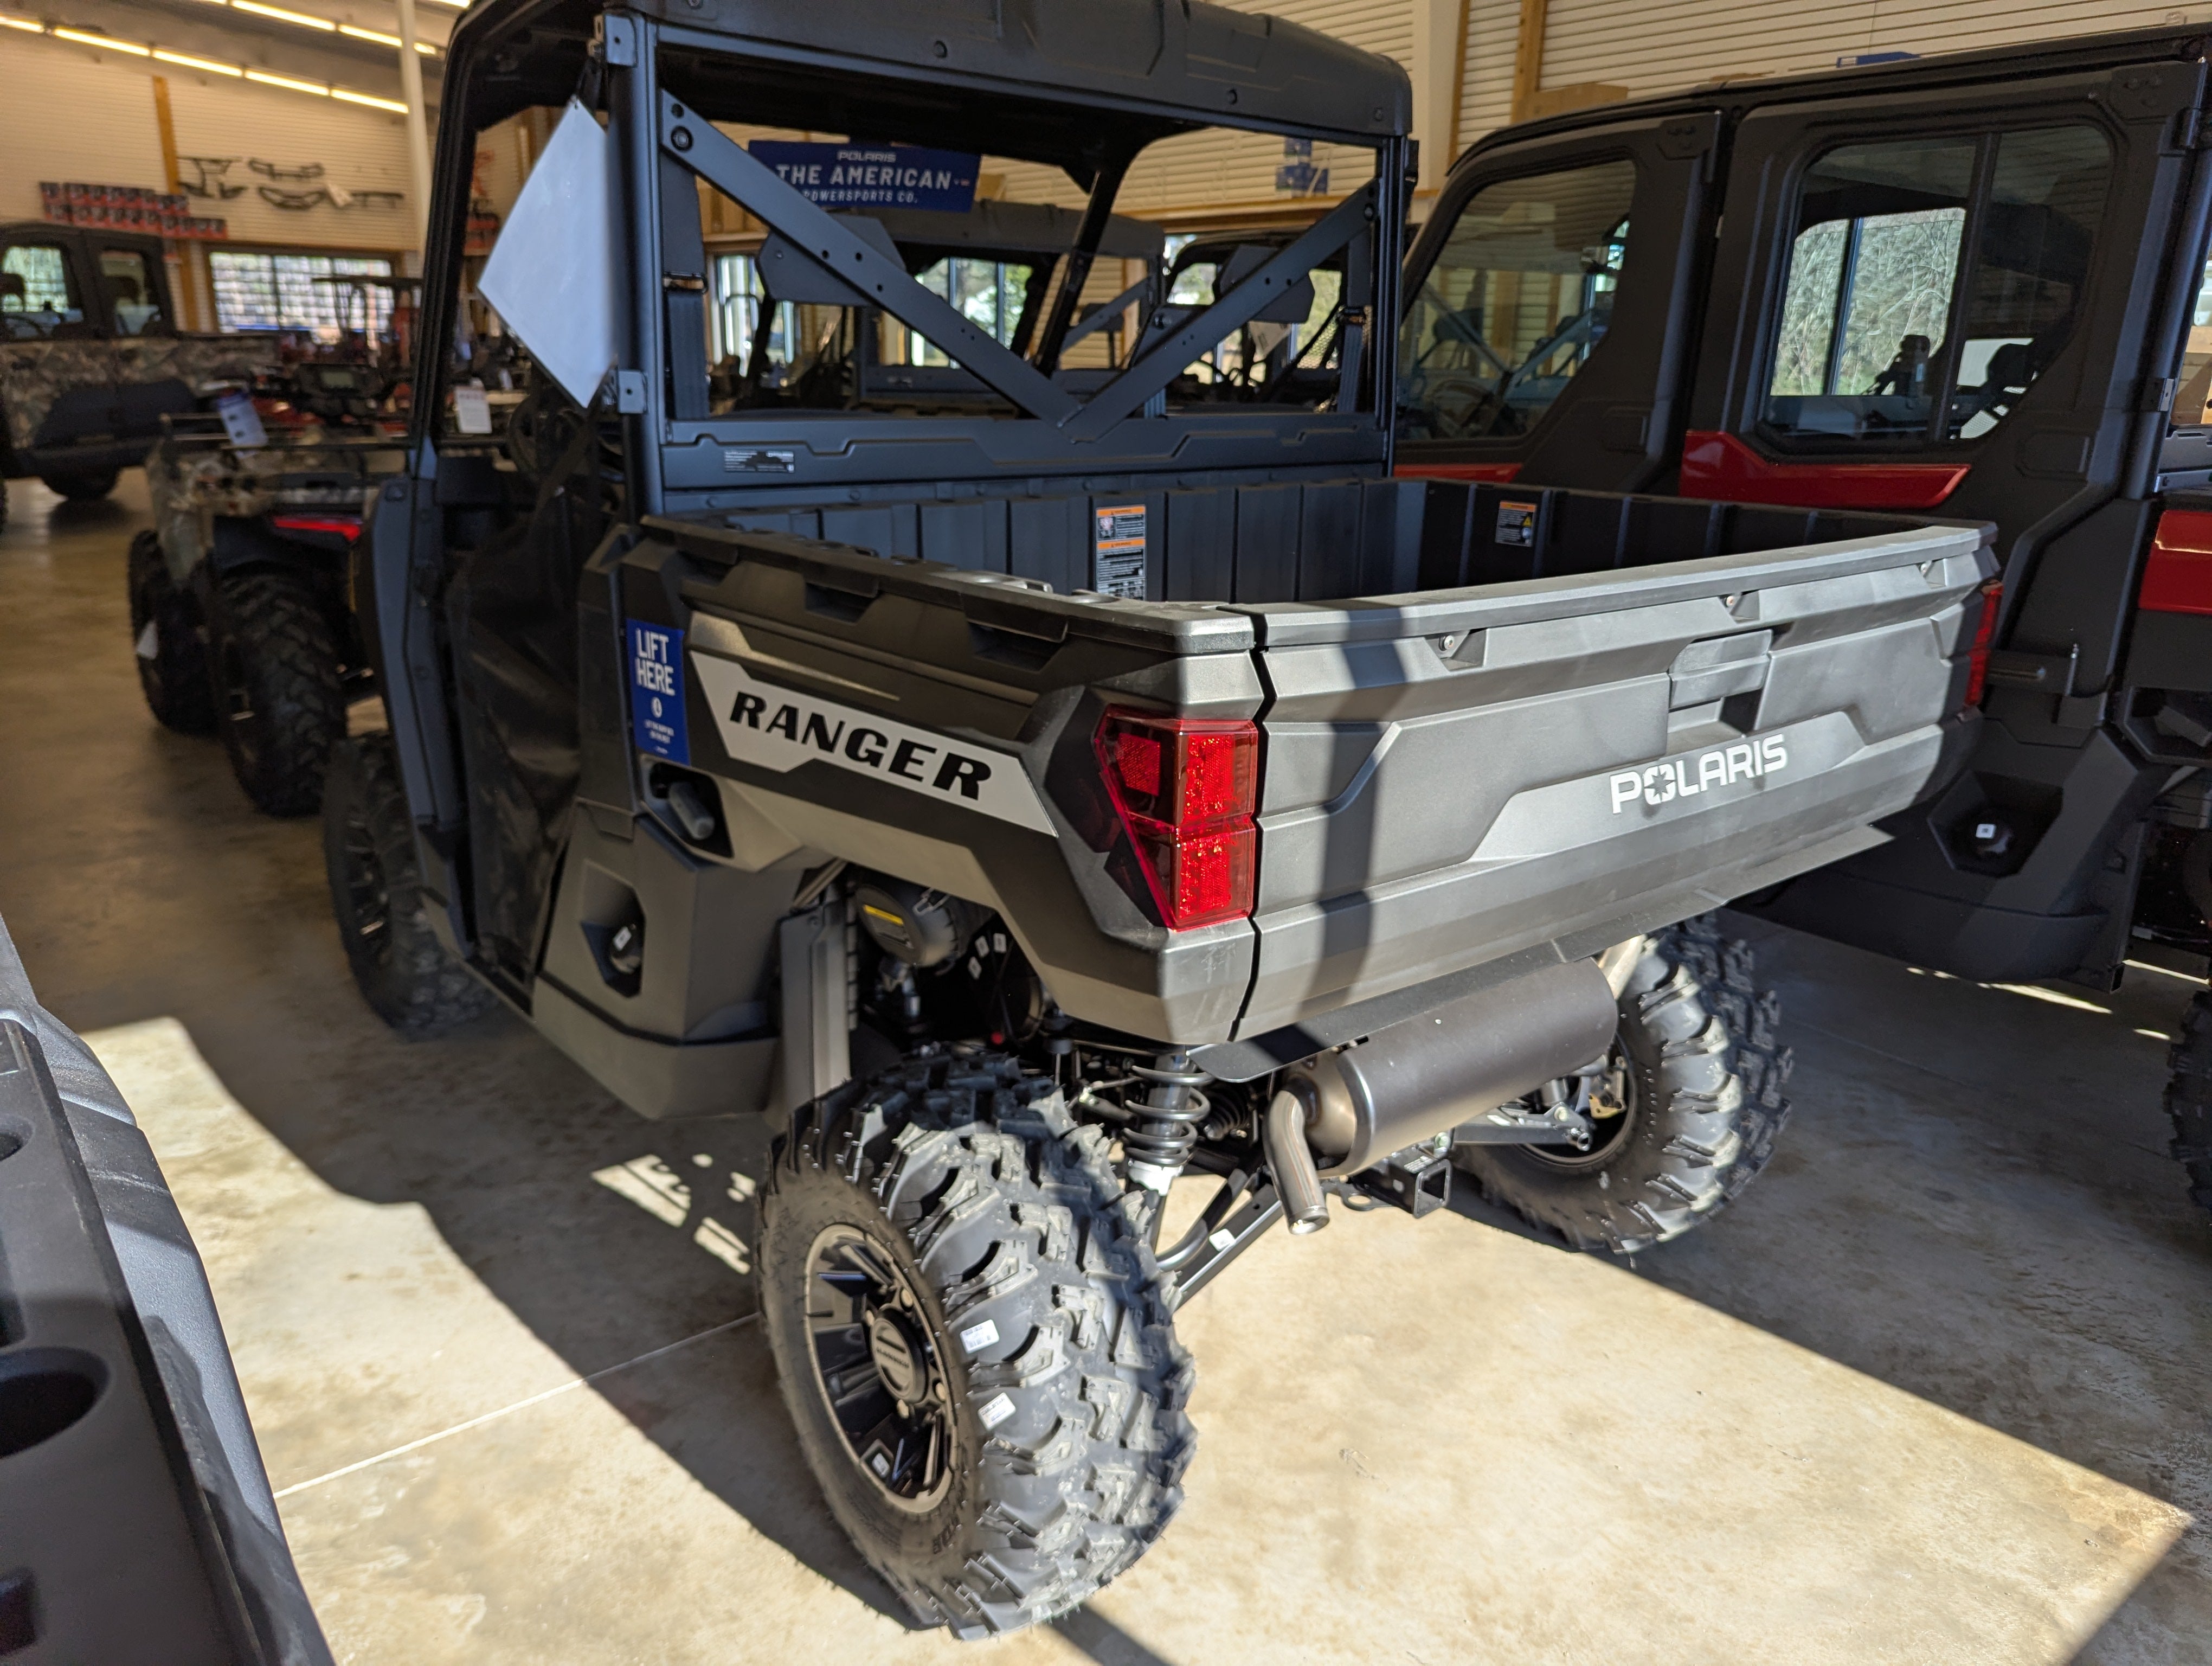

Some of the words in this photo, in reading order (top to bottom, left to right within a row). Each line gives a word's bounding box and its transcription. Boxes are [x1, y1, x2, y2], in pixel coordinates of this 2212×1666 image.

[837, 150, 897, 163] POLARIS
[776, 164, 822, 185] THE
[829, 164, 952, 190] AMERICAN
[897, 190, 918, 203] CO.
[635, 627, 669, 664] LIFT
[635, 657, 676, 696] HERE
[730, 691, 992, 800] RANGER
[1609, 733, 1788, 814] POLARIS
